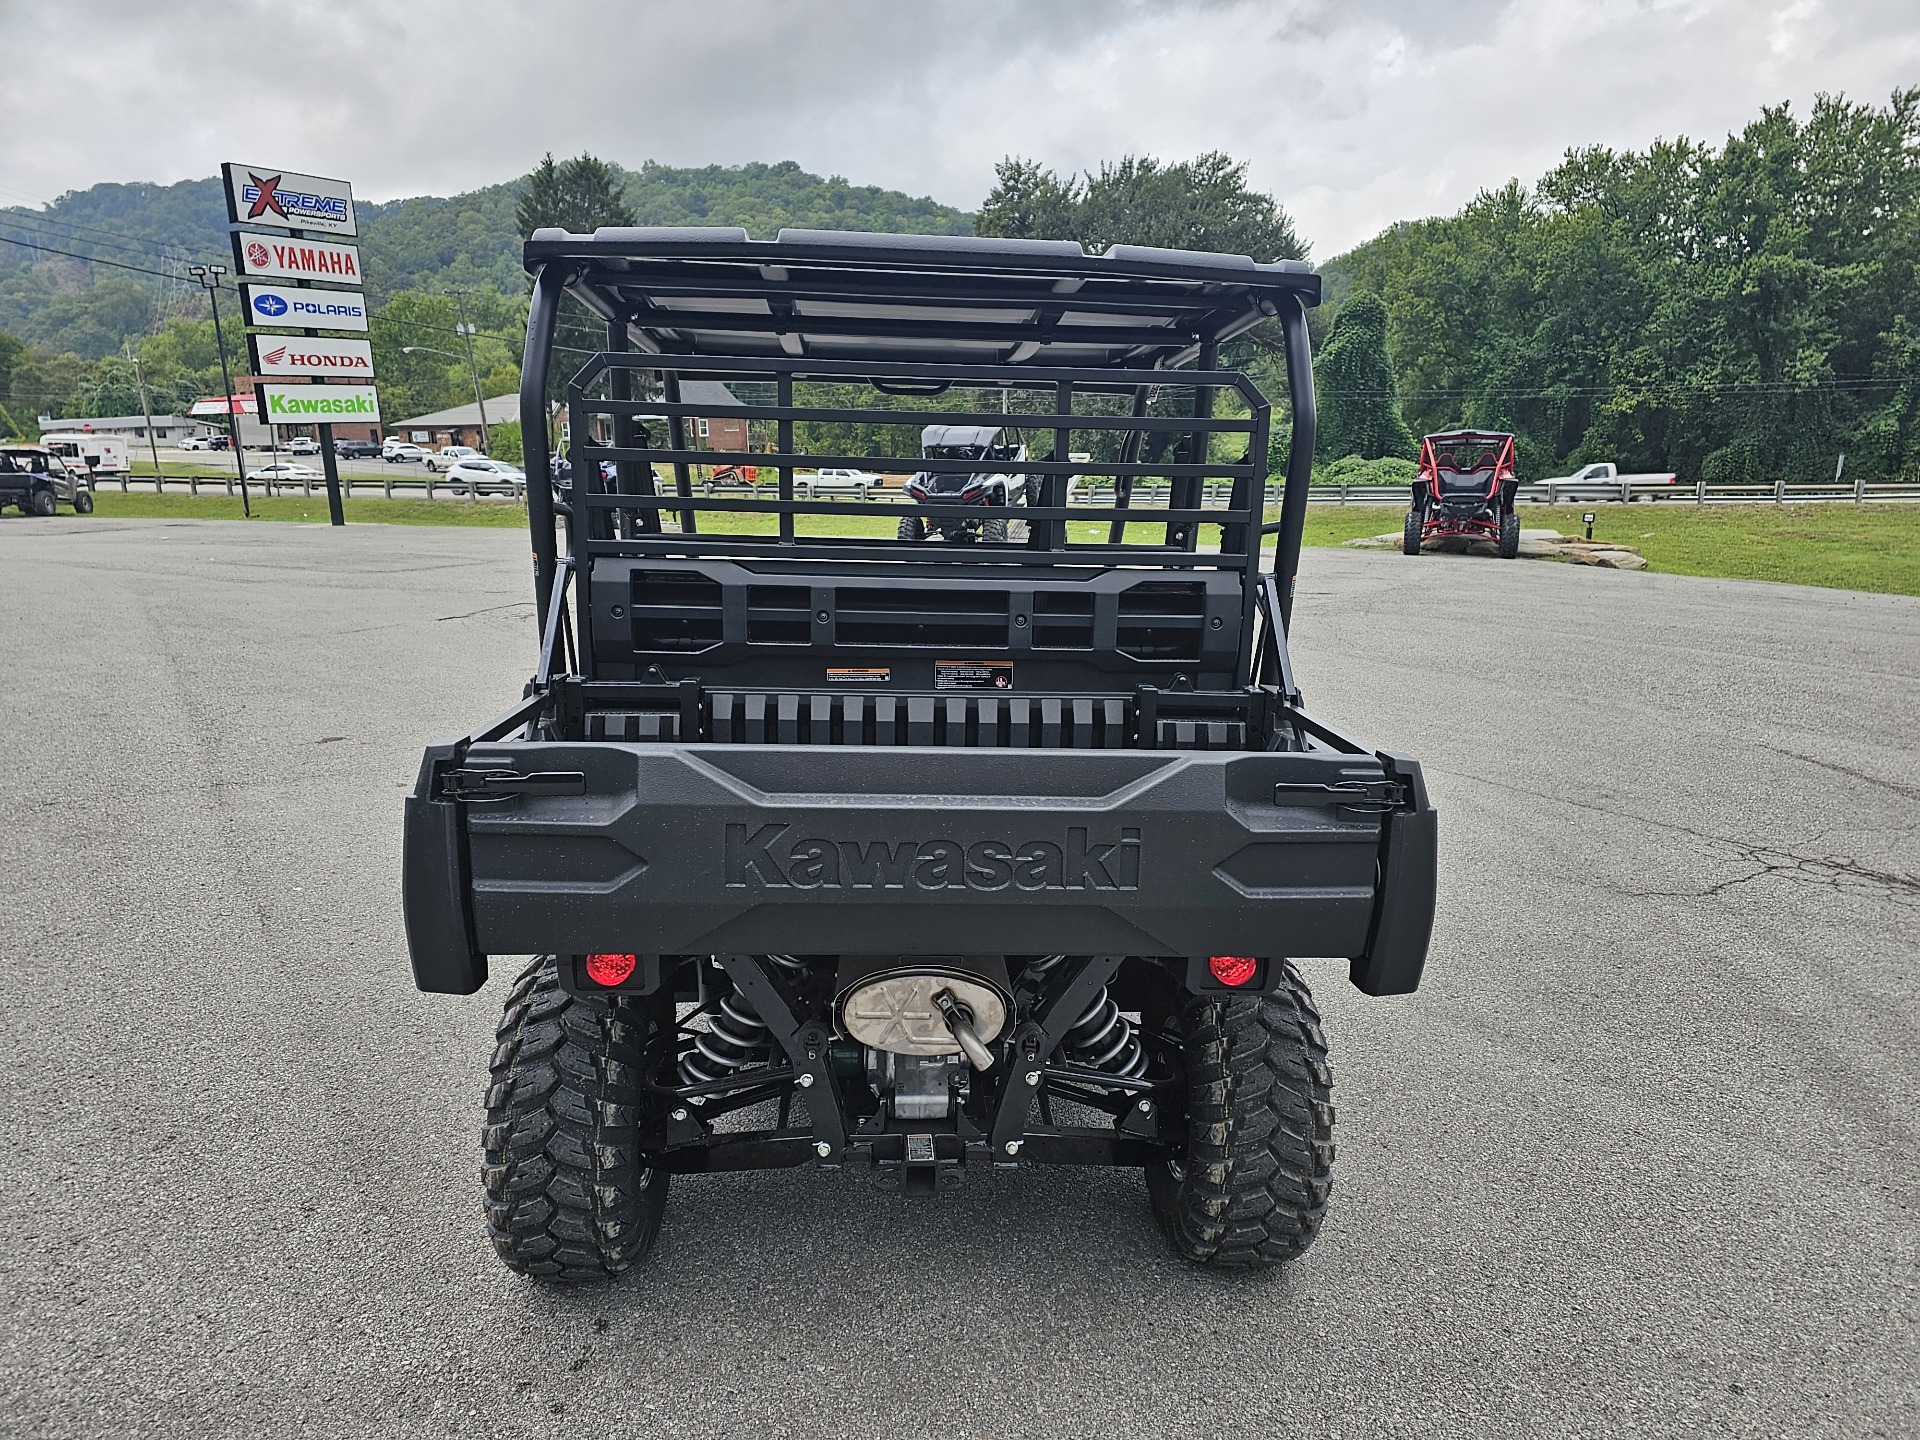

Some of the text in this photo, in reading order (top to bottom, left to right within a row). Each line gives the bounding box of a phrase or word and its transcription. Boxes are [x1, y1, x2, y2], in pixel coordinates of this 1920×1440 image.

[243, 171, 347, 220] EXTREME
[288, 206, 346, 221] POWERSPORTS
[273, 244, 356, 276] YAMAHA
[293, 301, 362, 317] POLARIS
[288, 353, 370, 368] HONDA
[269, 392, 375, 414] Kawasaki
[725, 823, 1141, 891] Kawasaki
